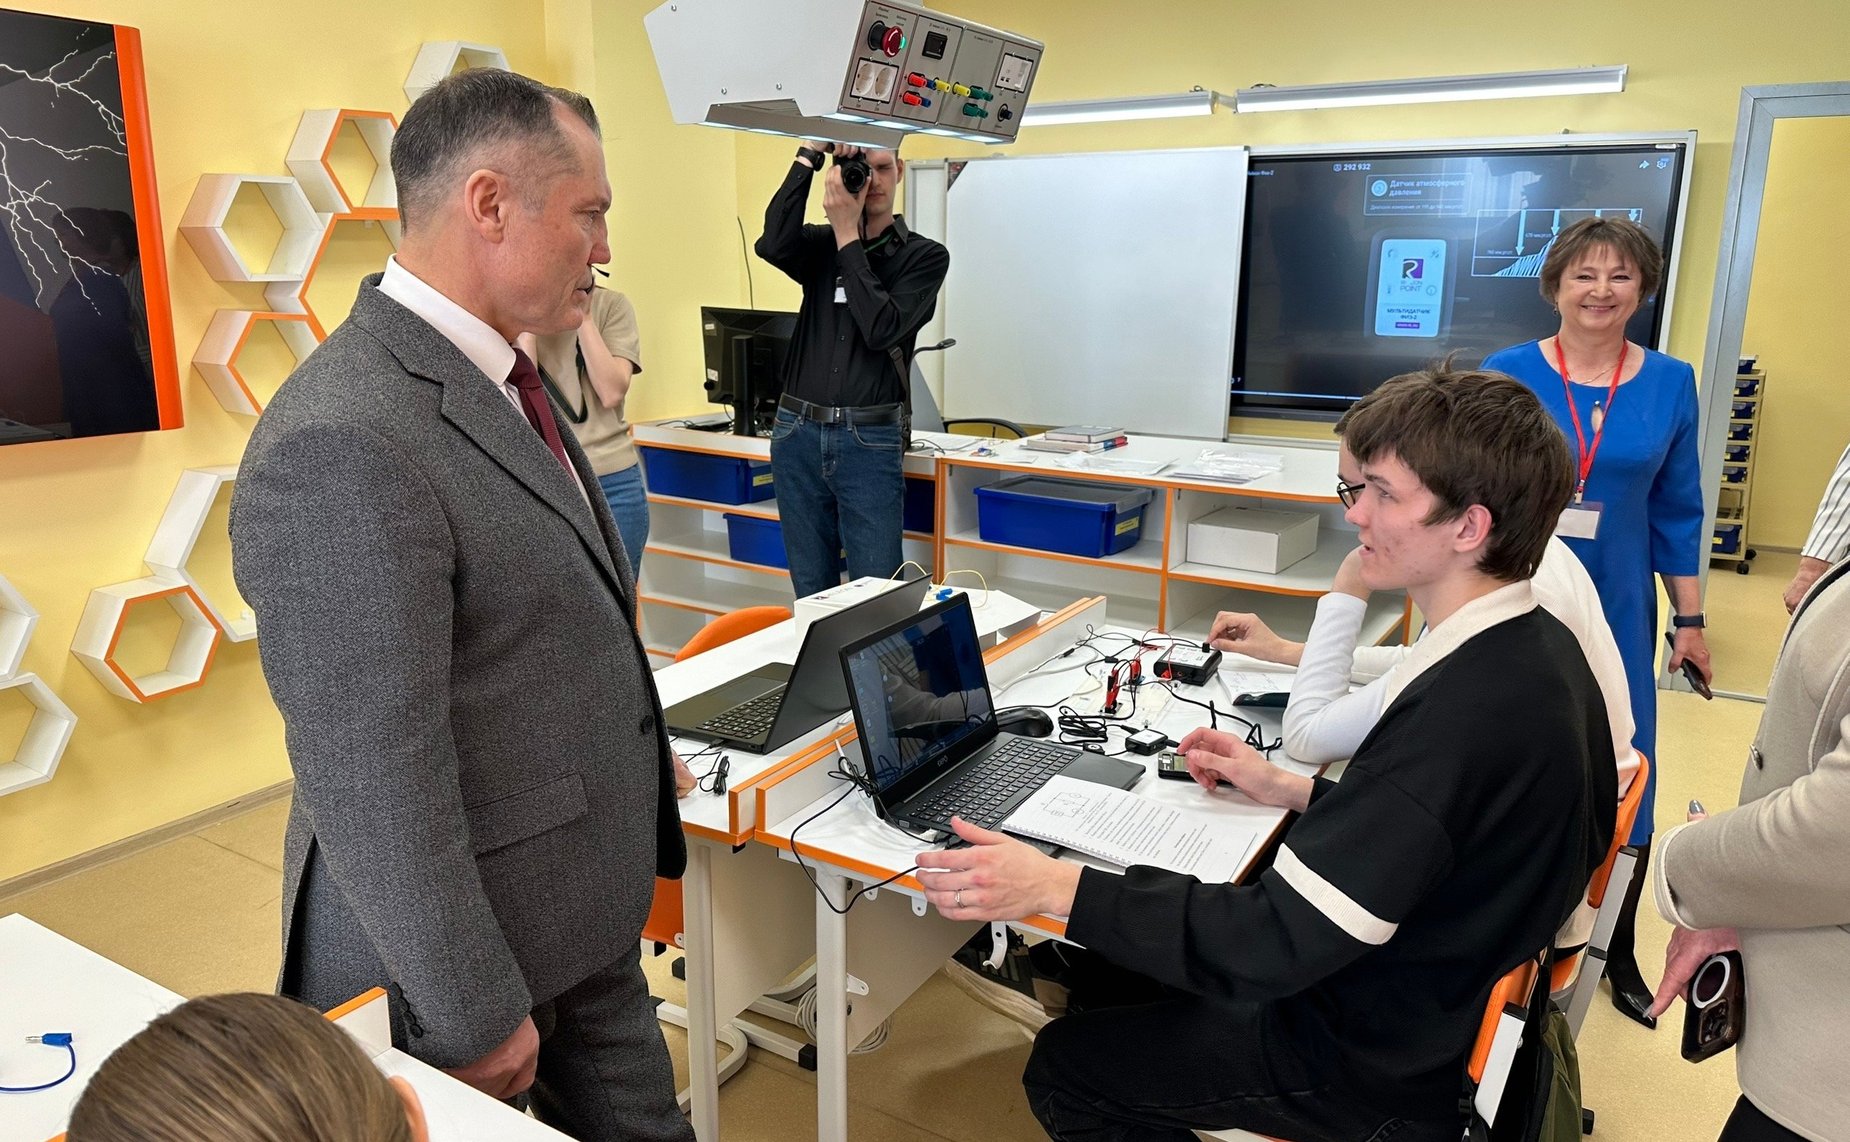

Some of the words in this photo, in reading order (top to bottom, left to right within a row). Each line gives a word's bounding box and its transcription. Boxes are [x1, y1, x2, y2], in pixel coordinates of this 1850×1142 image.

[1390, 179, 1415, 189] Датчик
[1415, 179, 1465, 189] атмосферного
[1389, 189, 1422, 197] давления
